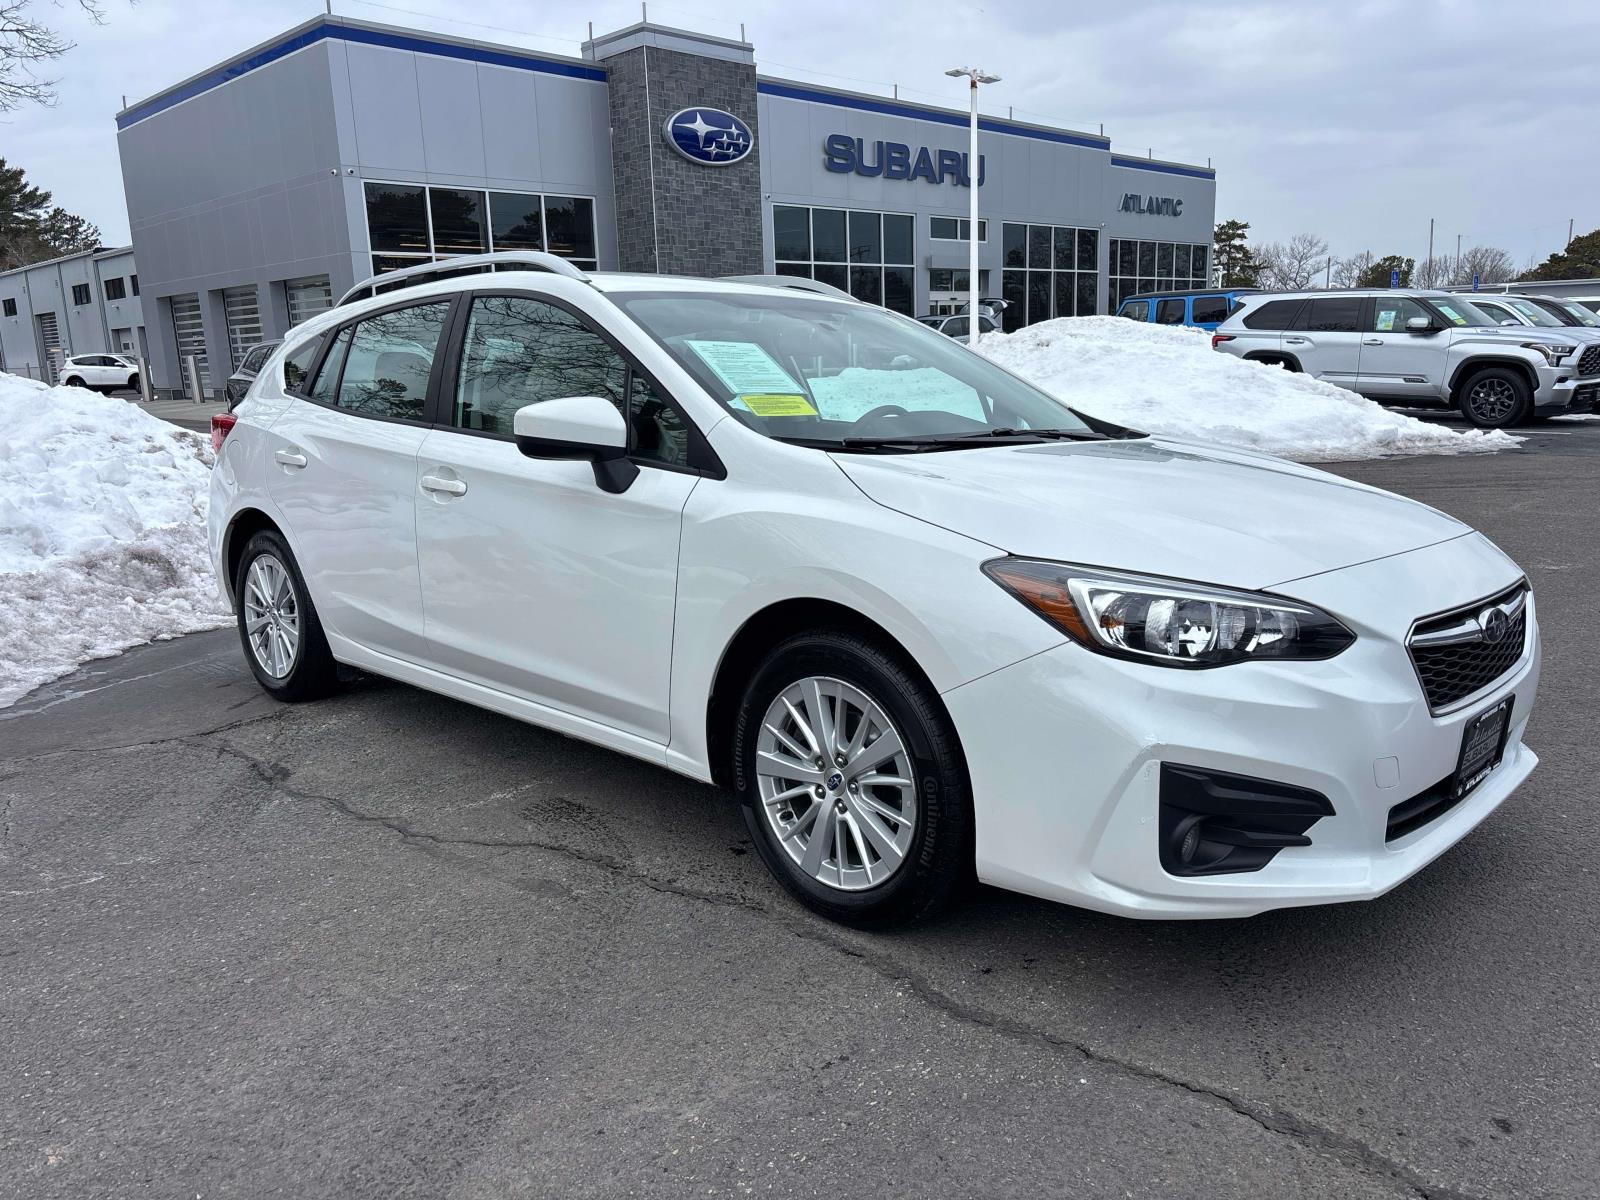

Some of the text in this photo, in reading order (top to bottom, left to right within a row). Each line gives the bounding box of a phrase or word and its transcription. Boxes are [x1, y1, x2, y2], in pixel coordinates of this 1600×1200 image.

[824, 134, 985, 187] SUBARU
[1118, 193, 1183, 217] ATLANTIC
[920, 776, 938, 867] Continental
